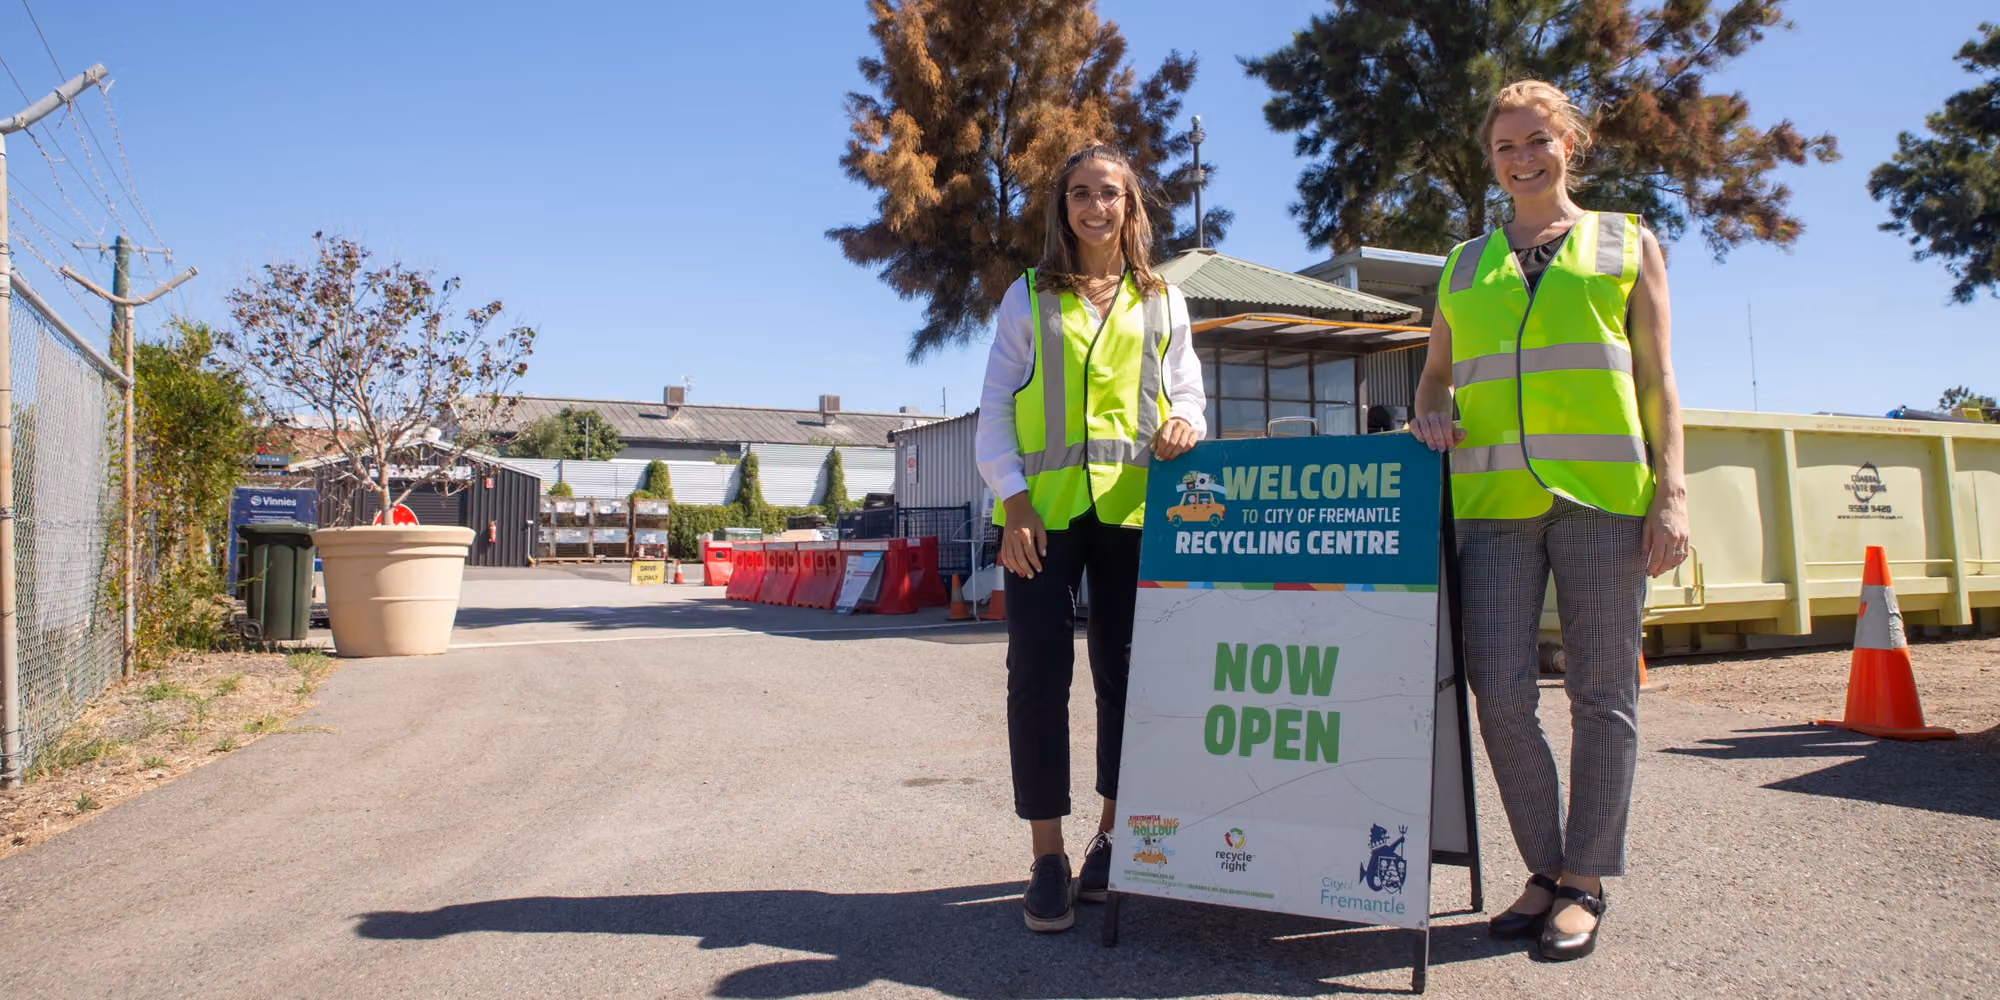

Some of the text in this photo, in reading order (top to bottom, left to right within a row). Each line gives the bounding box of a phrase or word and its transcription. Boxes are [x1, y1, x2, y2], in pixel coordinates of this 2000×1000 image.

[1222, 462, 1401, 500] WELCOME
[262, 496, 297, 506] Vinnies
[1242, 507, 1401, 524] TO CITY OF FREMANTLE
[1175, 530, 1399, 555] RECYCLING CENTRE
[1213, 642, 1340, 697] NOW
[1204, 704, 1341, 764] OPEN
[1127, 817, 1180, 828] RECYCLING
[1132, 825, 1178, 836] ROLLOUT
[1215, 850, 1252, 862] recycle
[1220, 860, 1247, 873] right
[1321, 876, 1344, 891] City
[1320, 889, 1406, 914] Fremantle
